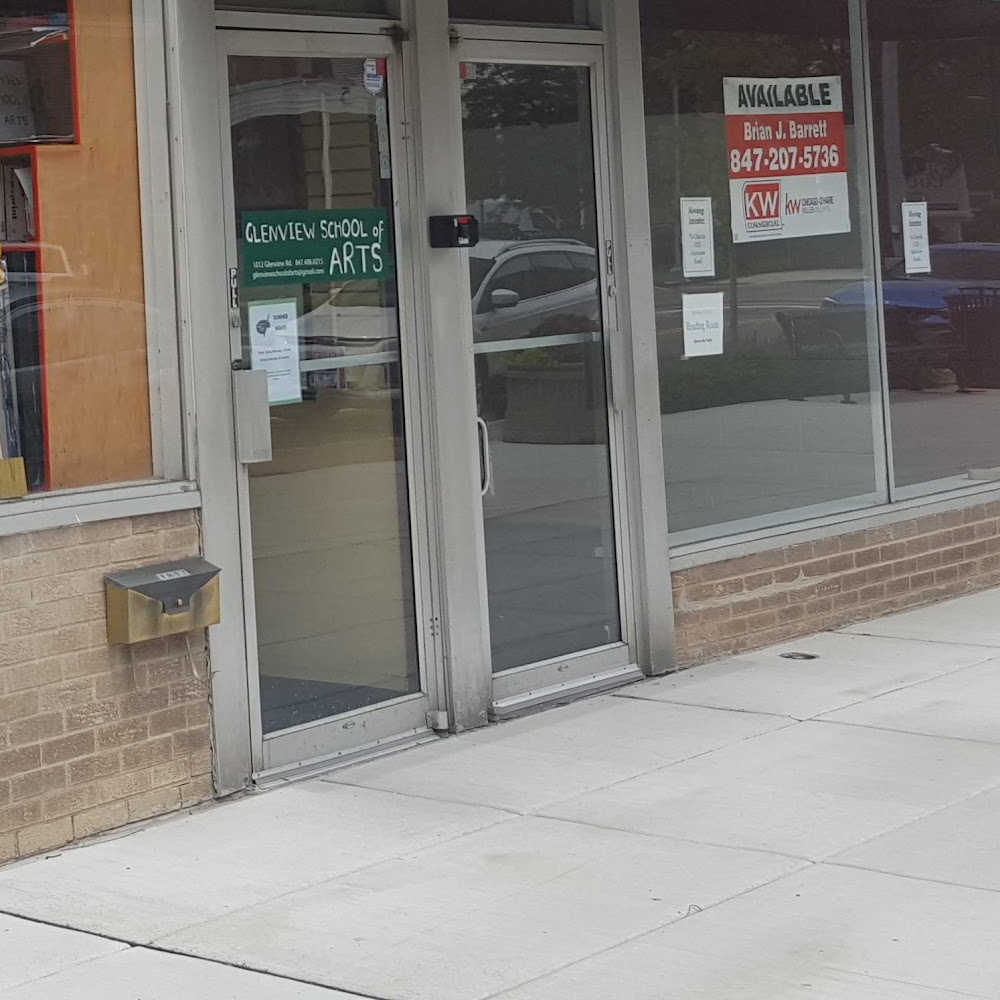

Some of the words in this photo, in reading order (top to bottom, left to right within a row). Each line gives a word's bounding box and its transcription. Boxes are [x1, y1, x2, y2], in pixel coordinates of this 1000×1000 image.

[738, 83, 831, 108] AVAILABLE
[743, 121, 772, 141] Brian
[775, 121, 786, 140] J.
[788, 120, 827, 139] Barrett
[730, 144, 839, 173] 847-207-5736
[745, 190, 779, 218] KW
[245, 222, 315, 243] GLENVIEW
[319, 218, 368, 239] SCHOOL
[372, 220, 385, 243] of
[329, 241, 384, 276] ARTS
[230, 268, 238, 308] PULL
